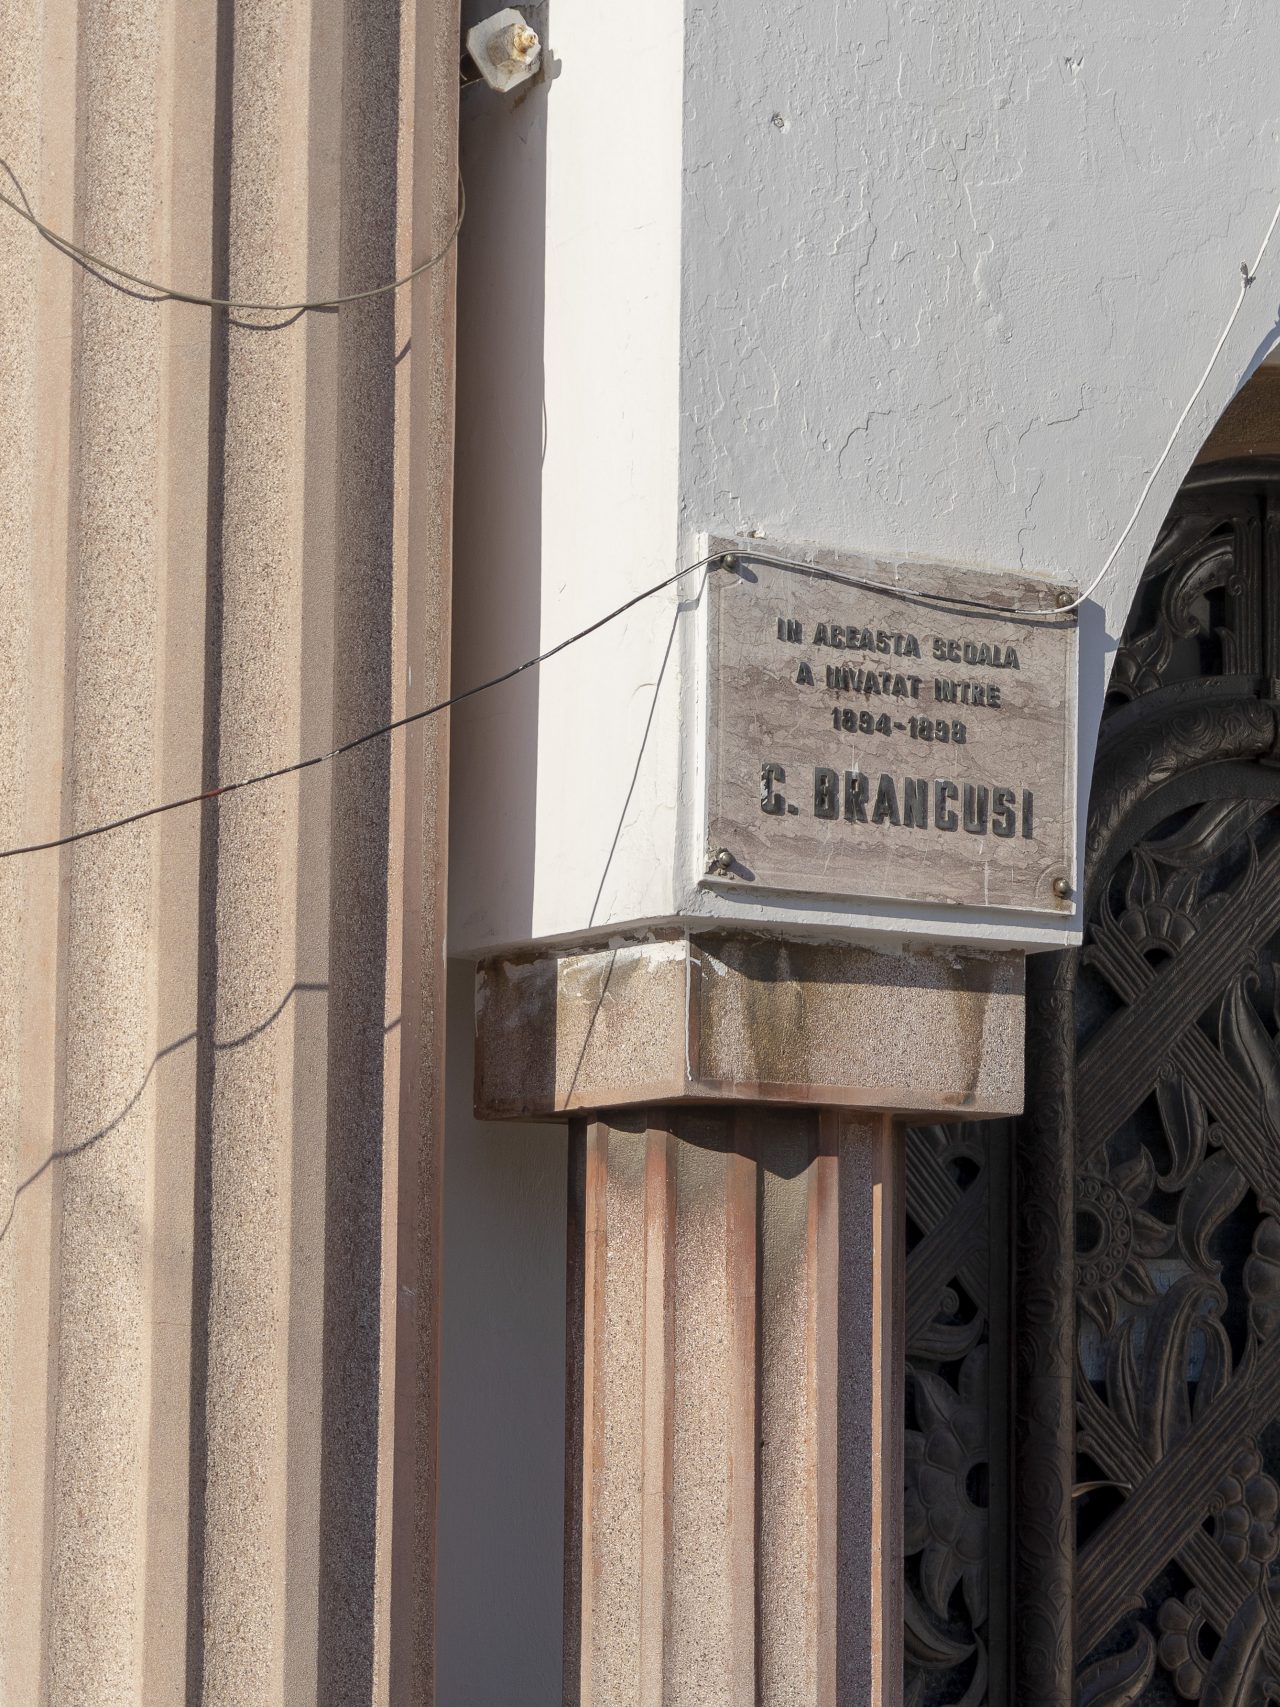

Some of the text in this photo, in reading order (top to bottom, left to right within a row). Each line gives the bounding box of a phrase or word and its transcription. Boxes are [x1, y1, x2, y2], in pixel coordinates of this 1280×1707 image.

[777, 617, 1021, 670] IN ACEASTA SCOALA
[796, 662, 1001, 708] A INVATAT INTRE
[831, 706, 967, 744] 1894-1898
[761, 762, 1034, 840] C. BRANCUSI
